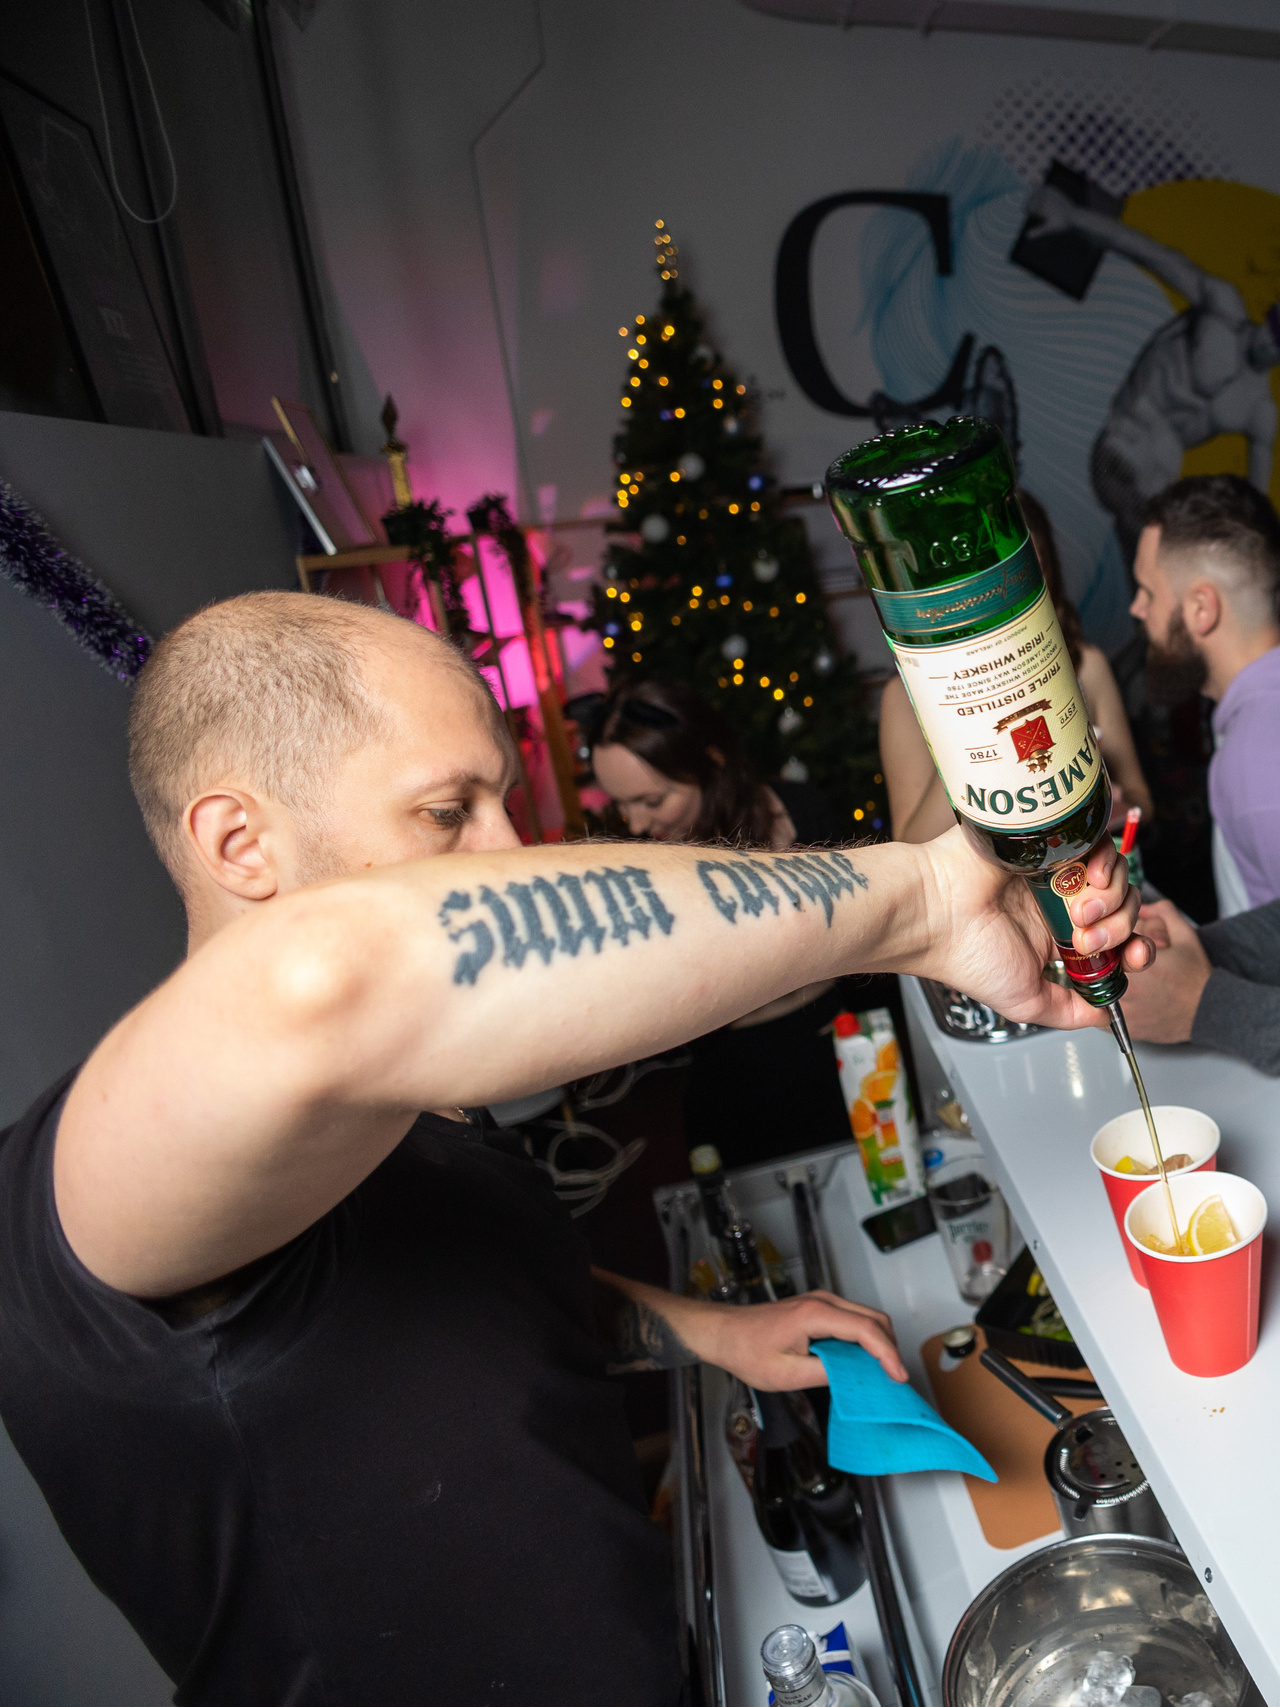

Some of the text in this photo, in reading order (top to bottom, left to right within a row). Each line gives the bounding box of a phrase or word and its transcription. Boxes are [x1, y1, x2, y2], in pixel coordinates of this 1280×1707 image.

[1003, 626, 1027, 643] PRODUCT
[952, 632, 1044, 680] IRISH WHISKEY
[966, 644, 993, 656] IRELAND
[1039, 643, 1058, 664] SMOOTH
[947, 639, 1052, 692] JOHN JAMESON WAY SINCE 1780
[1022, 661, 1039, 676] IRISH
[957, 662, 1061, 716] TRIPLE DISTILLED
[985, 673, 1020, 693] WHISKEY
[961, 689, 984, 698] MADE
[969, 749, 998, 760] 1780
[966, 721, 1097, 815] JAMESON
